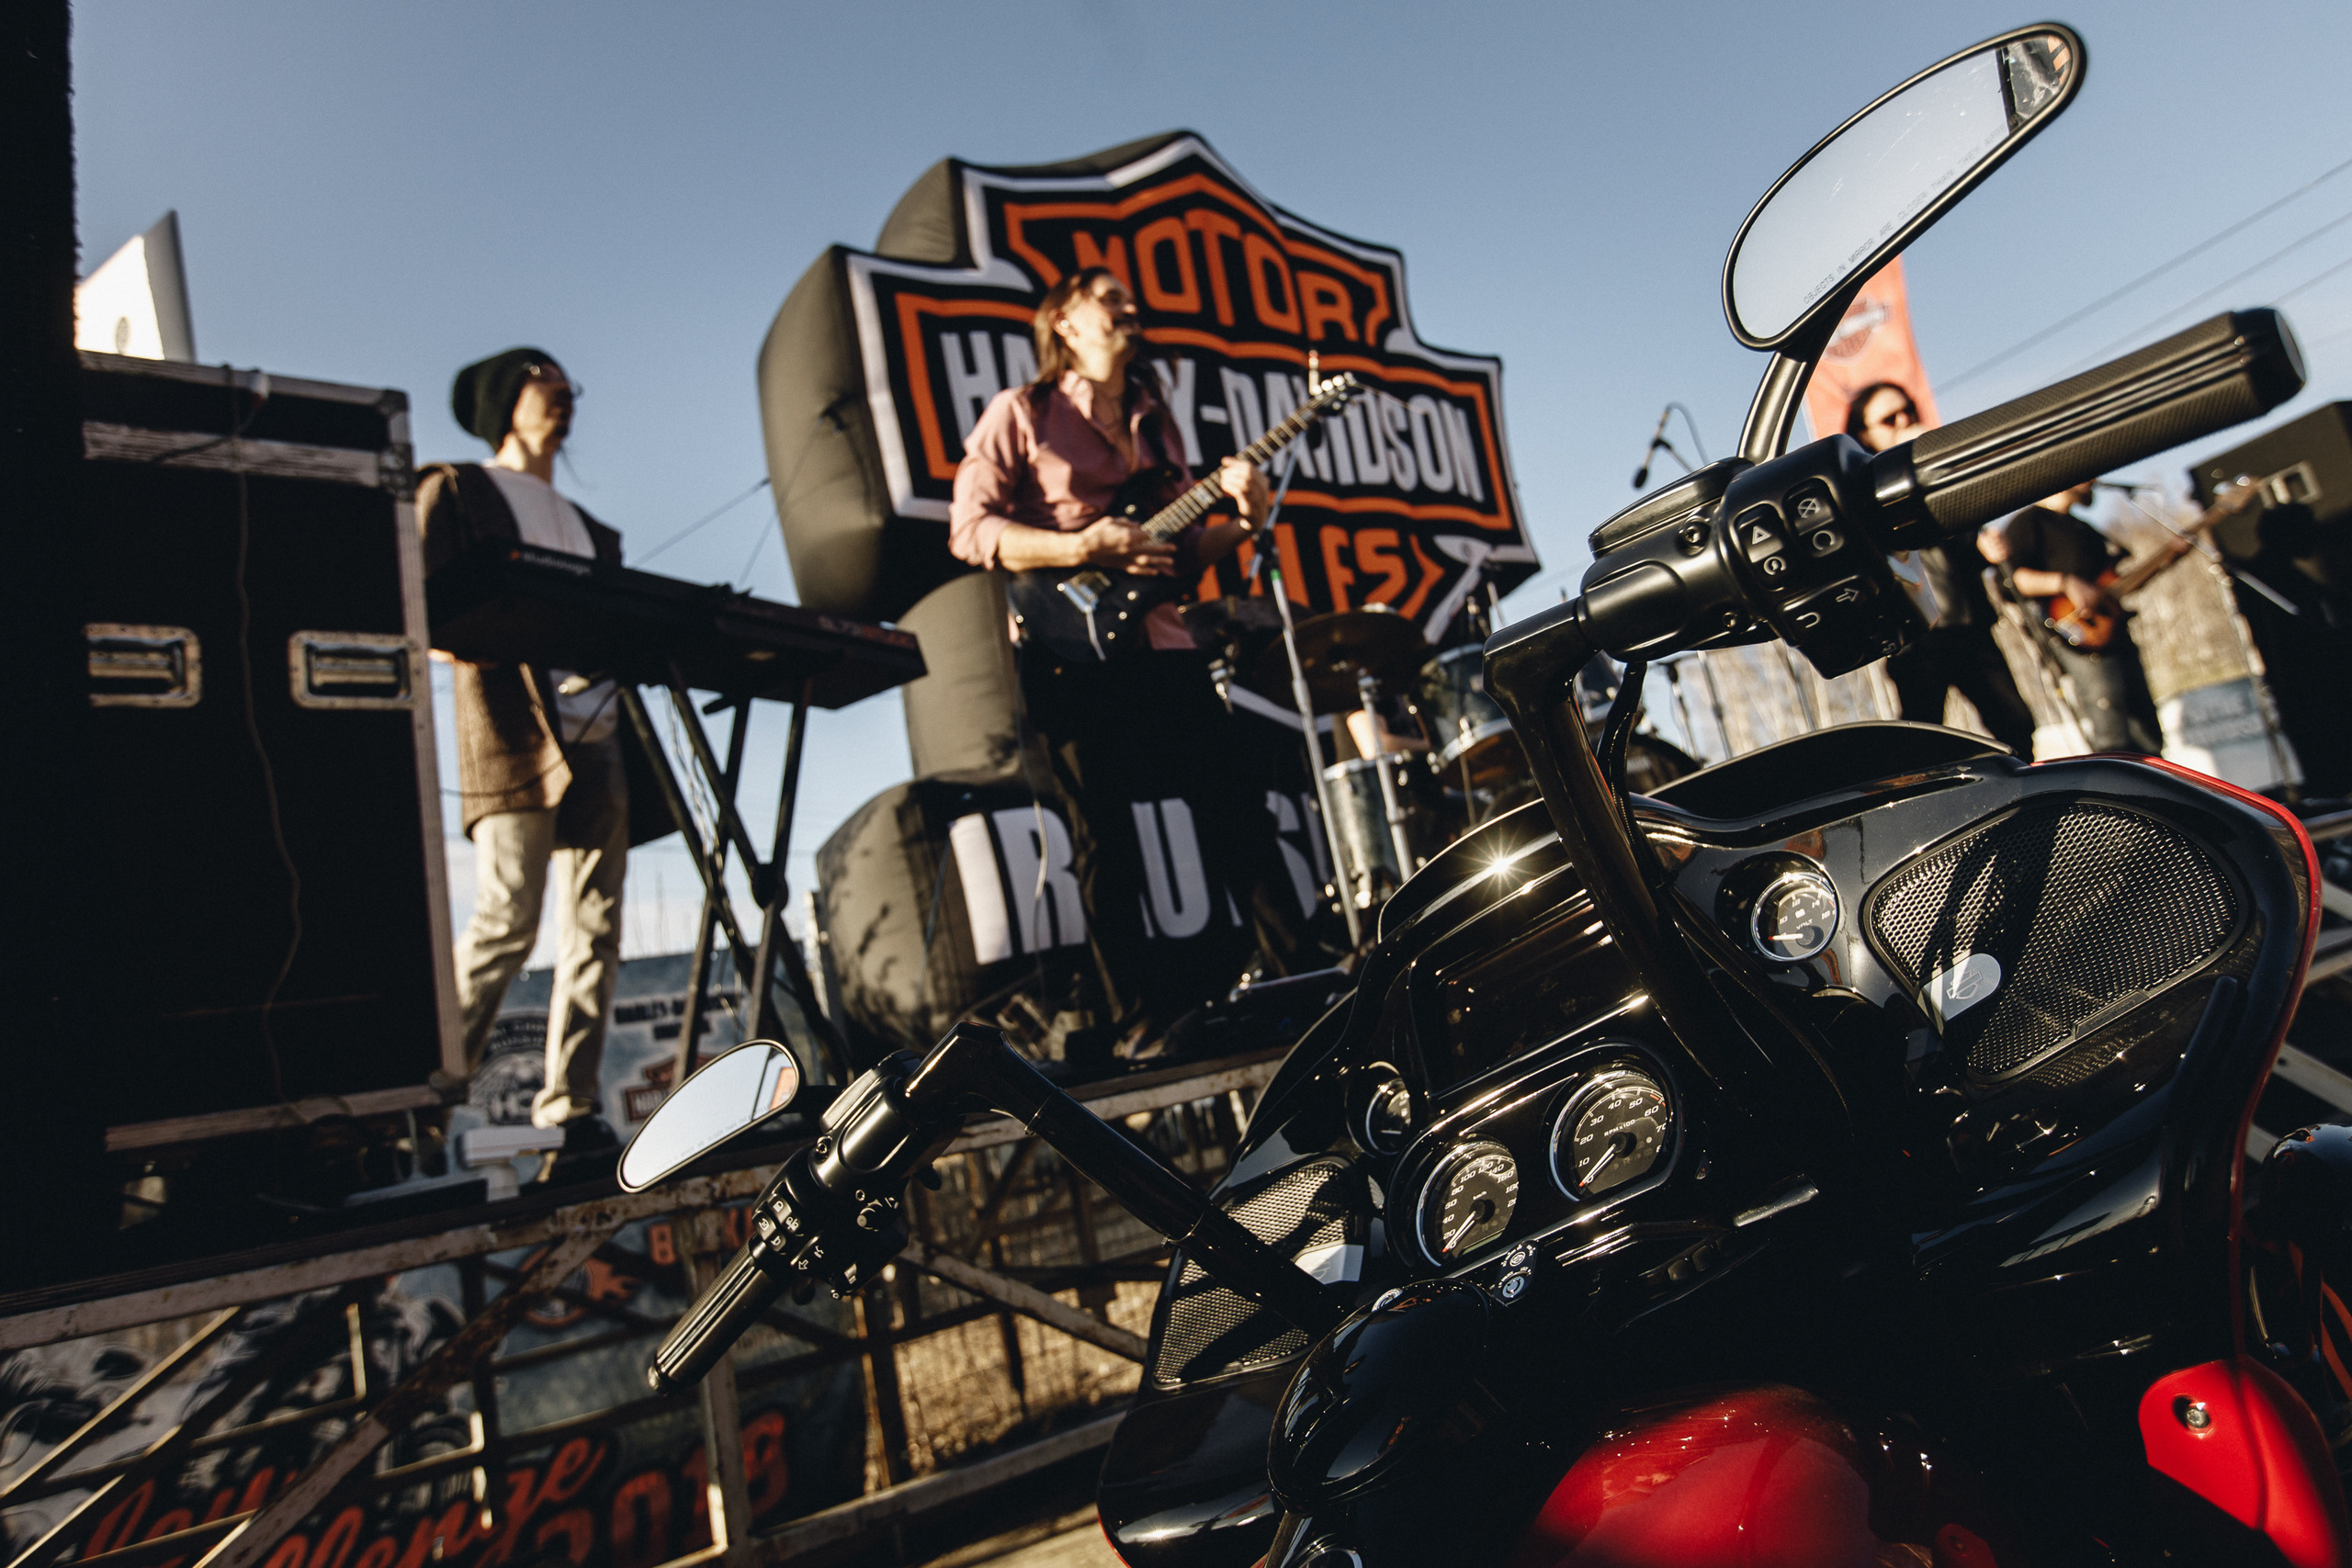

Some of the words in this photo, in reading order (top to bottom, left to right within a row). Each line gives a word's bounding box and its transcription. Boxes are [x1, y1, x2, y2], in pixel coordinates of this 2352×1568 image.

[1803, 274, 1836, 305] OBJECTS
[1836, 264, 1848, 276] IN
[1848, 237, 1875, 265] MIRROR
[1879, 221, 1894, 238] ARE
[1896, 191, 1928, 220] CLOSER
[1930, 168, 1957, 192] THAN
[1812, 899, 1820, 908] 14
[1780, 916, 1788, 924] 10
[1608, 1099, 1622, 1110] 40
[1628, 1097, 1644, 1109] 50
[1644, 1104, 1659, 1117] 60
[1589, 1114, 1604, 1126] 30
[1579, 1134, 1594, 1145] 20
[1577, 1156, 1590, 1168] 10
[1460, 1169, 1476, 1183] 100
[1488, 1163, 1505, 1177] 140
[1497, 1170, 1514, 1183] 160
[1451, 1184, 1464, 1196] 80
[1442, 1213, 1455, 1224] 40
[1442, 1228, 1456, 1240] 20
